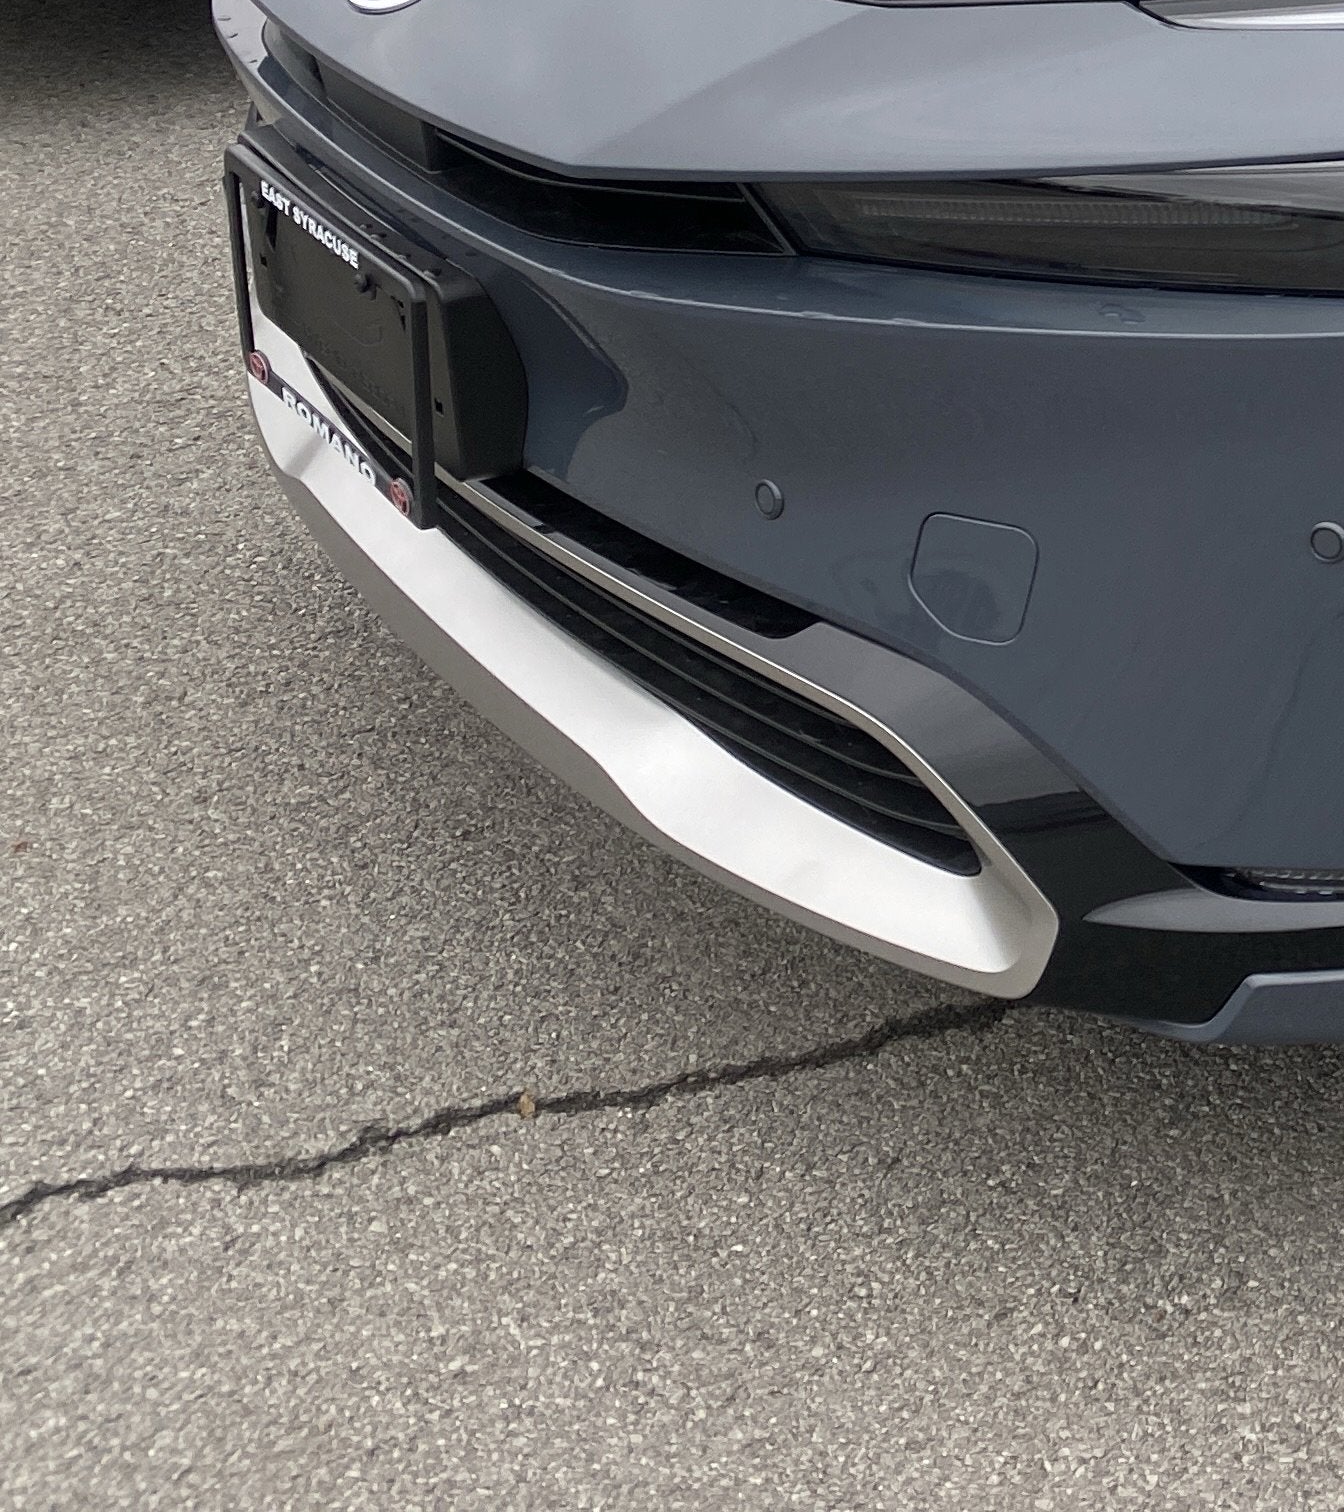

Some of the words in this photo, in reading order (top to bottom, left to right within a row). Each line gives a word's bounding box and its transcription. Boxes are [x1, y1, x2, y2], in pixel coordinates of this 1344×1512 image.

[261, 180, 290, 216] EAST
[292, 206, 359, 270] SYRACUSE
[282, 387, 376, 487] ROMANO
